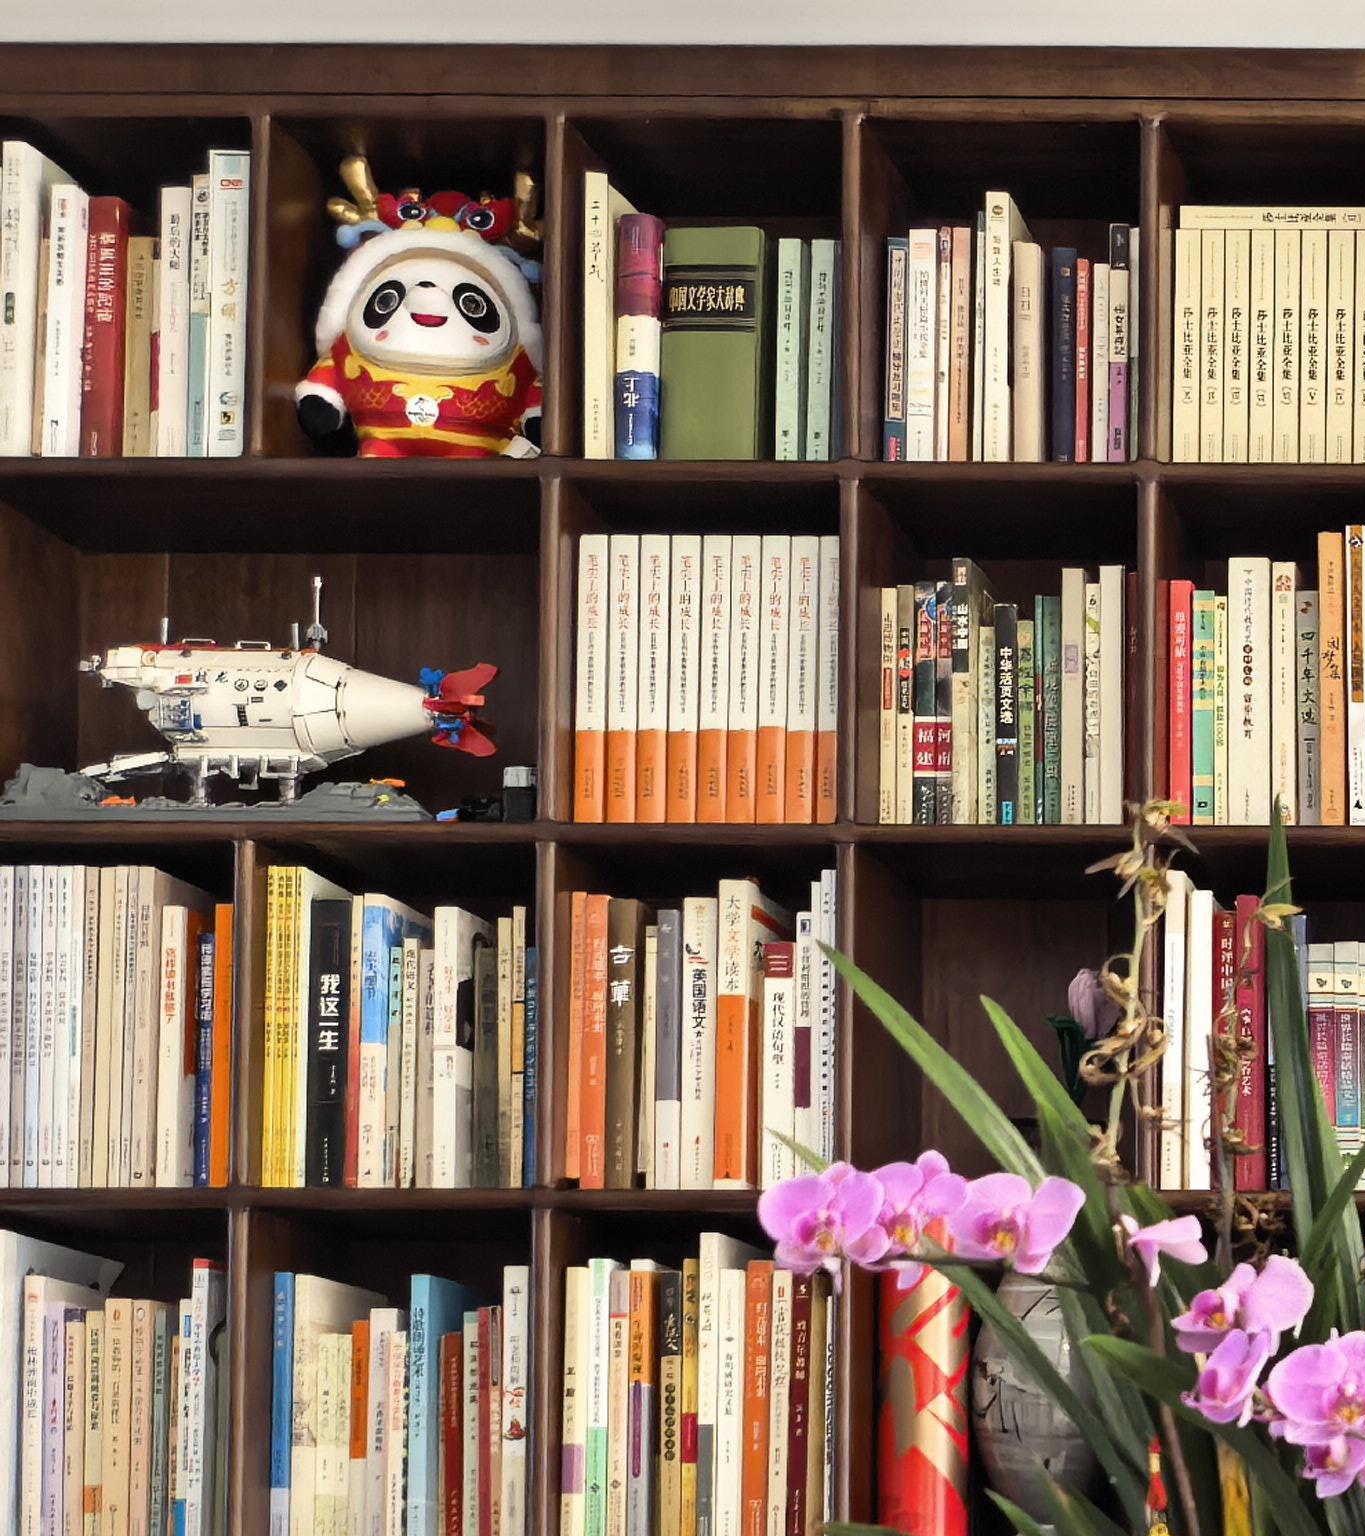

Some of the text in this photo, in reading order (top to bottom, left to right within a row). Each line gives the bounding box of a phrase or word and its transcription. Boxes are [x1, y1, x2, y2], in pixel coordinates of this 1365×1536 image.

[999, 646, 1014, 724] 中华活页文选
[916, 728, 935, 766] 福建
[318, 972, 340, 1052] 我这一生
